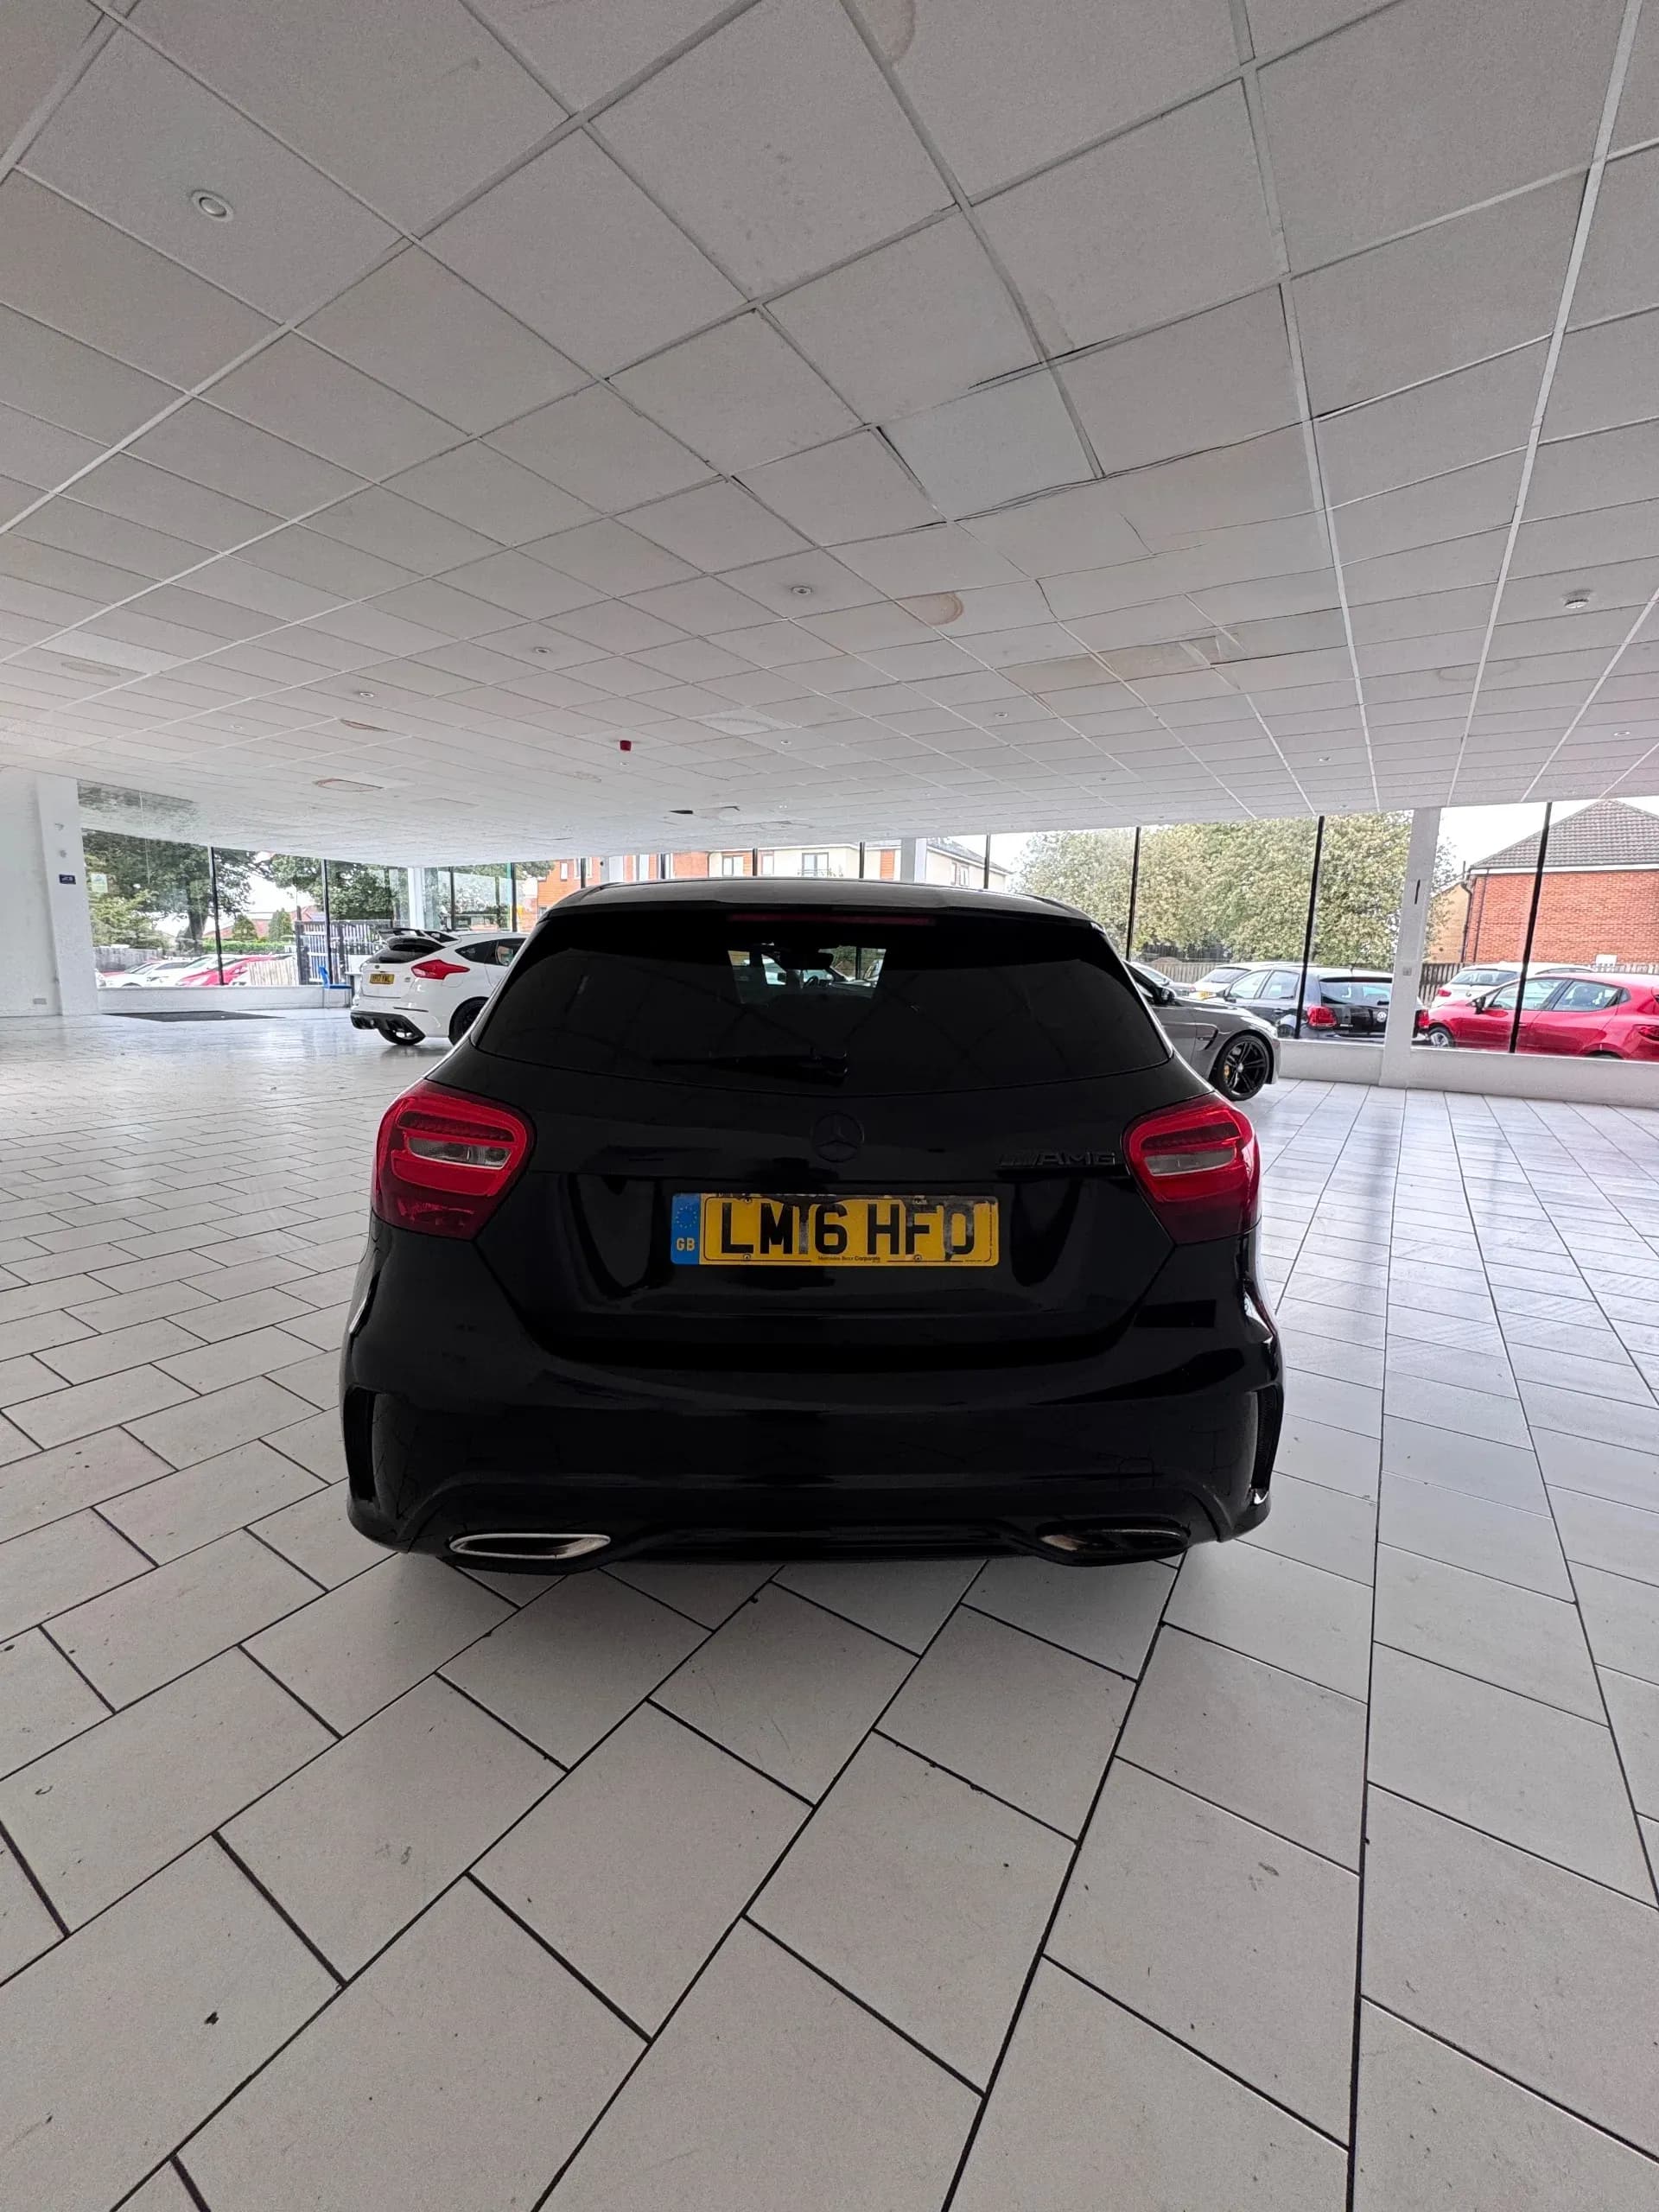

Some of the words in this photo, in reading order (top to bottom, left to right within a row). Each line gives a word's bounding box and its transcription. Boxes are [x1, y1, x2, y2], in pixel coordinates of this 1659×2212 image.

[1037, 1152, 1116, 1166] AMG
[721, 1203, 847, 1255] LM16
[676, 1237, 696, 1252] GB
